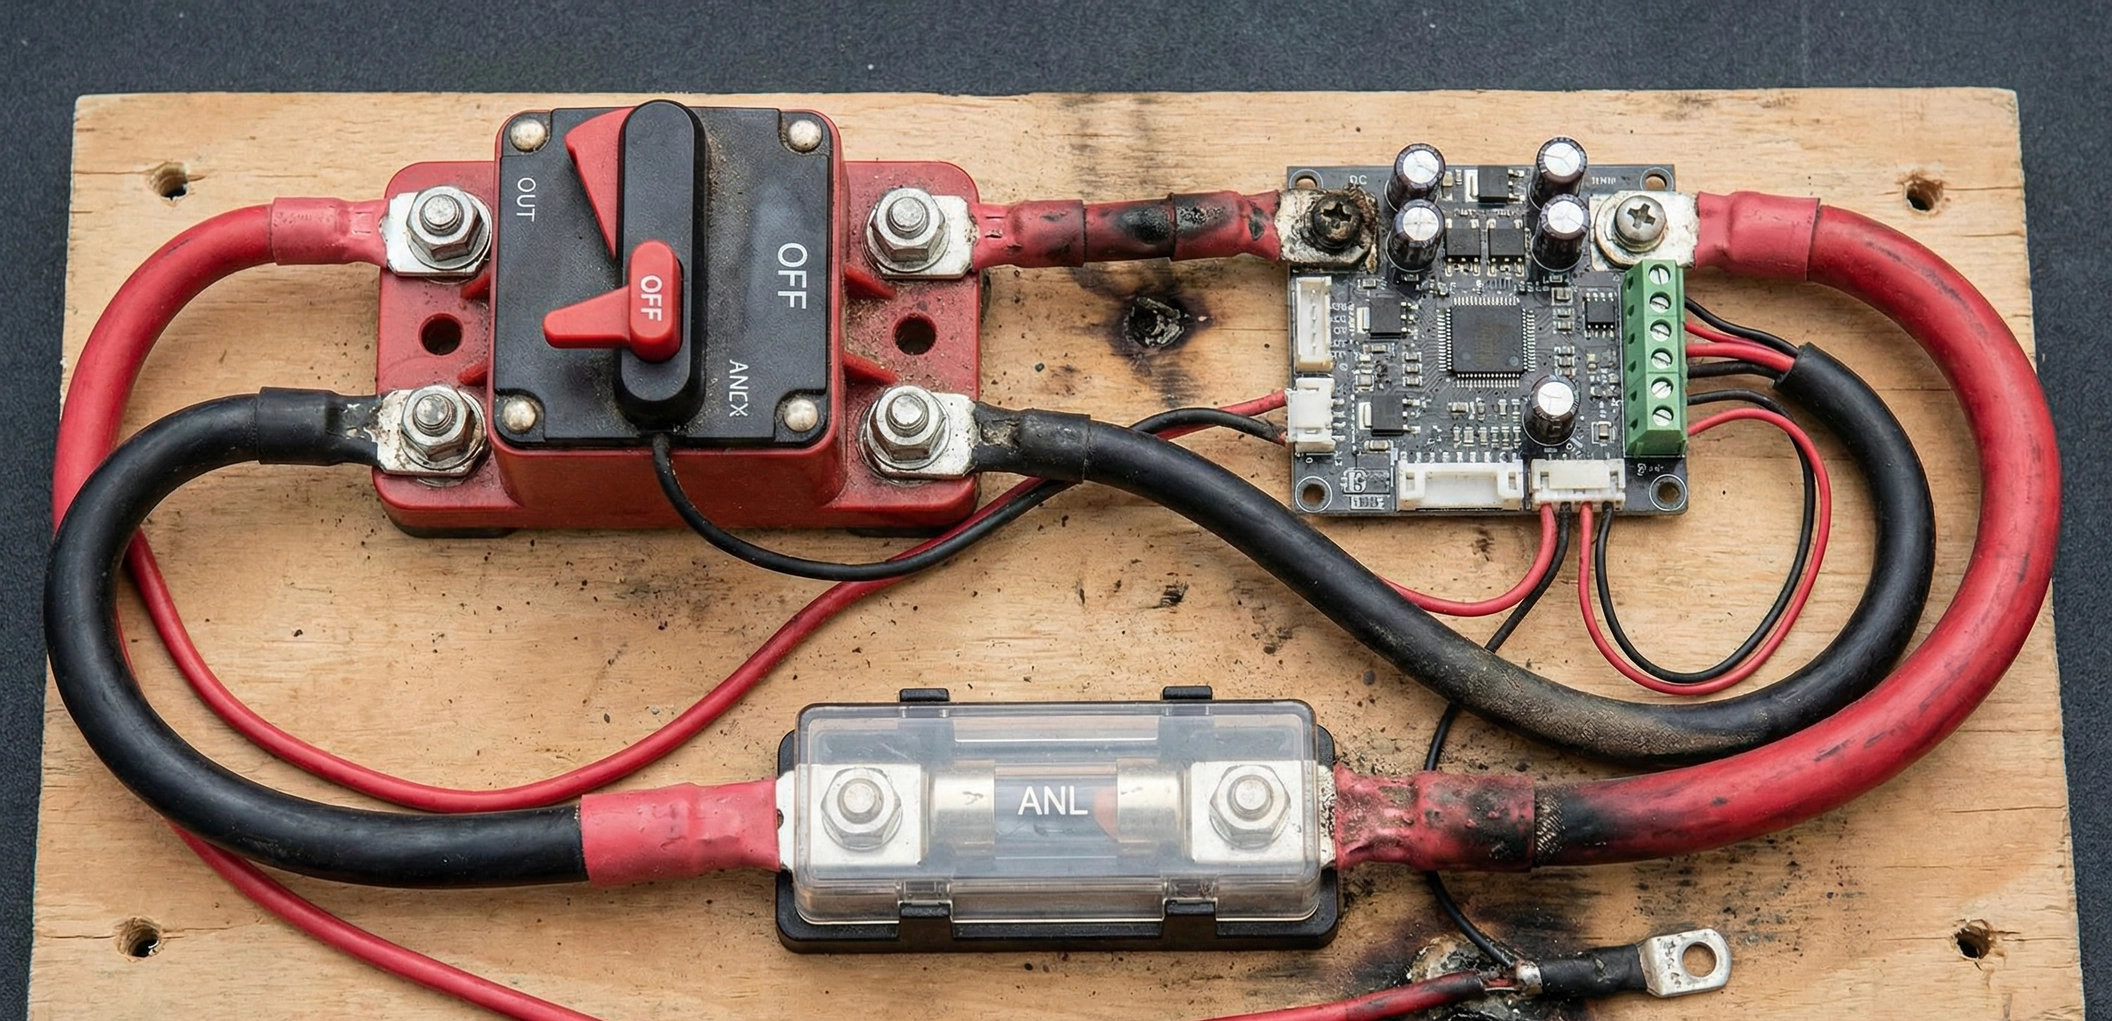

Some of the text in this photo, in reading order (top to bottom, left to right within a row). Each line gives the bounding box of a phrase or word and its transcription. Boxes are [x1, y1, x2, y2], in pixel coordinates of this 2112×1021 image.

[516, 177, 536, 222] OUT
[640, 275, 663, 322] OFF
[777, 242, 808, 310] OFF
[1017, 785, 1089, 816] ANL
